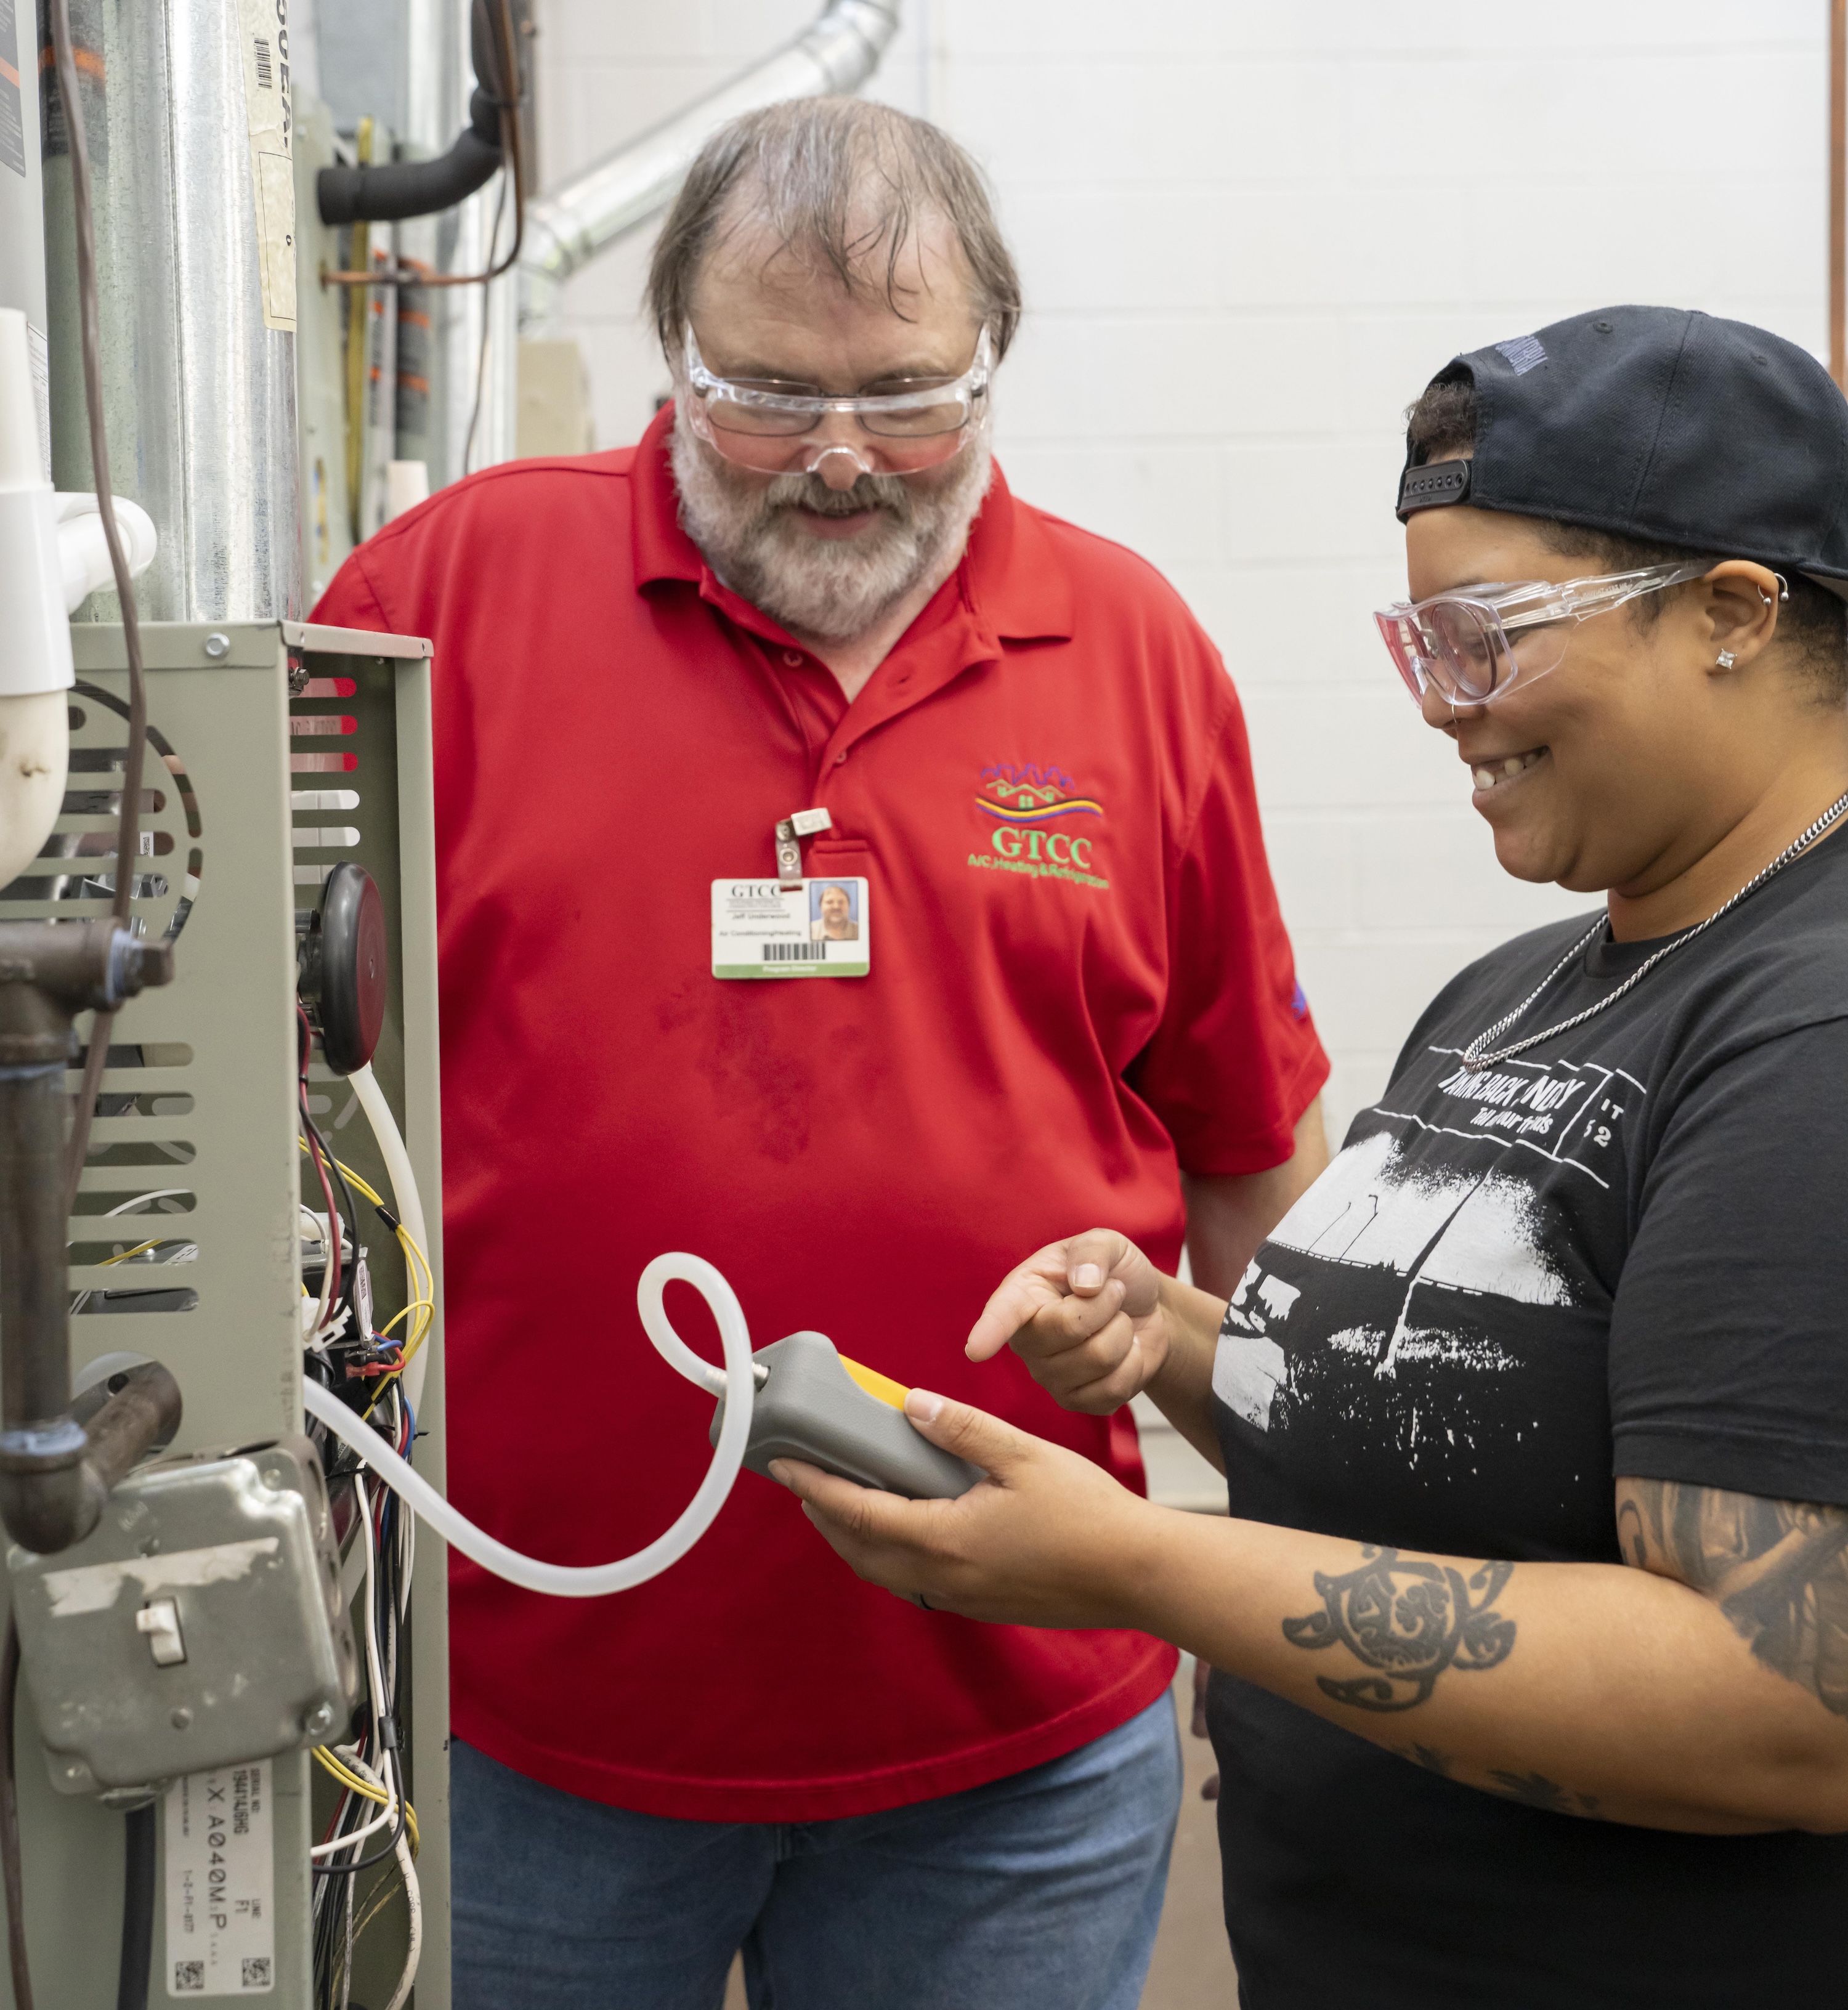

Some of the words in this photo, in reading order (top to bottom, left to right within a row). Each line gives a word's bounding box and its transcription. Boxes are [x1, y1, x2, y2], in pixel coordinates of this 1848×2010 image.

[992, 827, 1092, 869] GTCC
[732, 885, 782, 898] GTCC
[1472, 1073, 1530, 1107] BACK
[1470, 1106, 1497, 1127] Tell
